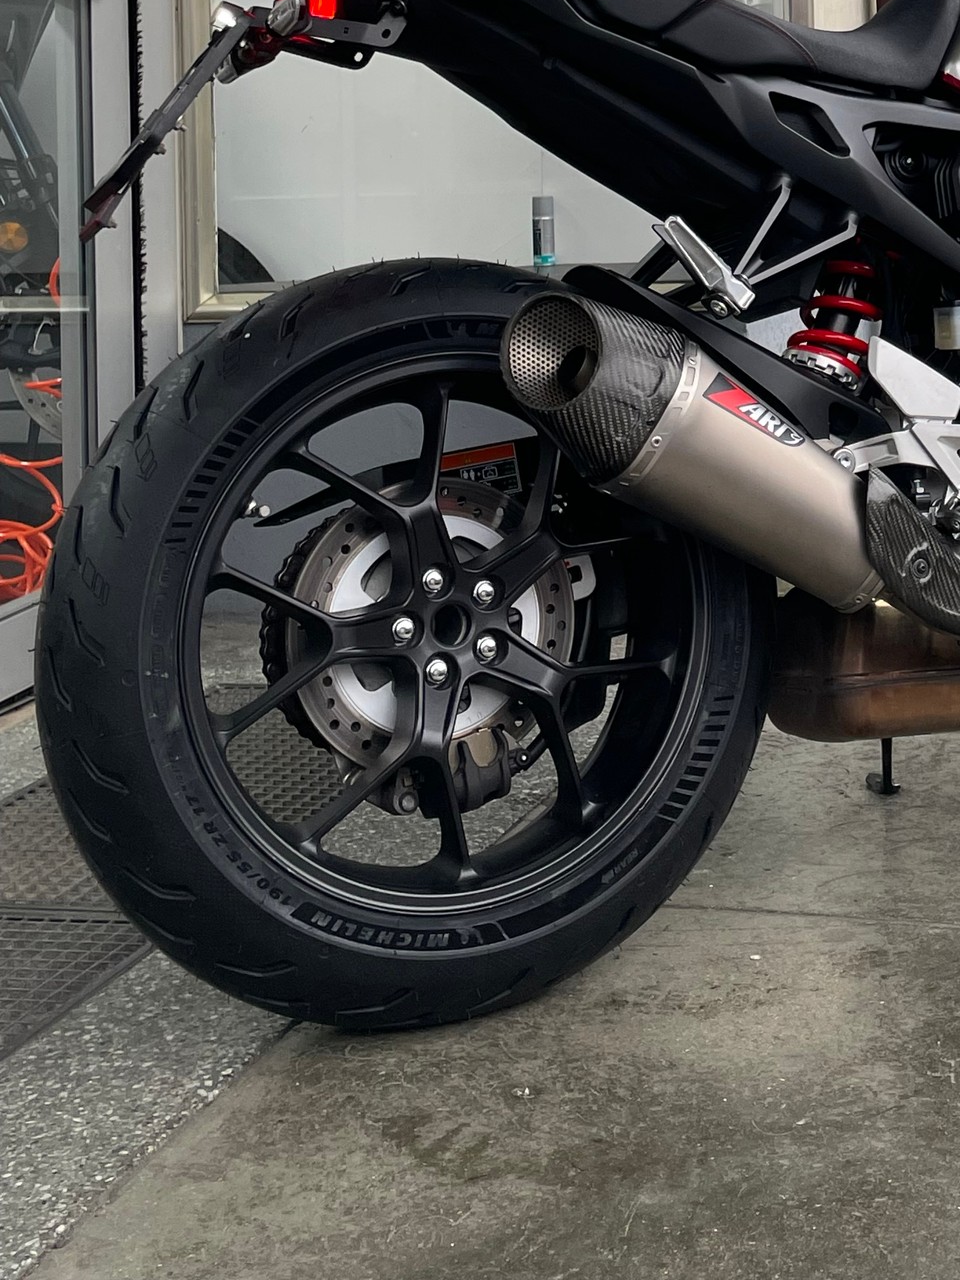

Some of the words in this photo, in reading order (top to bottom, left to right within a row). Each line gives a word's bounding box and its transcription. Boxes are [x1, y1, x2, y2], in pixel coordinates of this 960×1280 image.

[185, 794, 206, 817] 17
[203, 820, 229, 848] ZR
[226, 850, 293, 907] 190/55
[311, 910, 450, 949] MICHELIN
